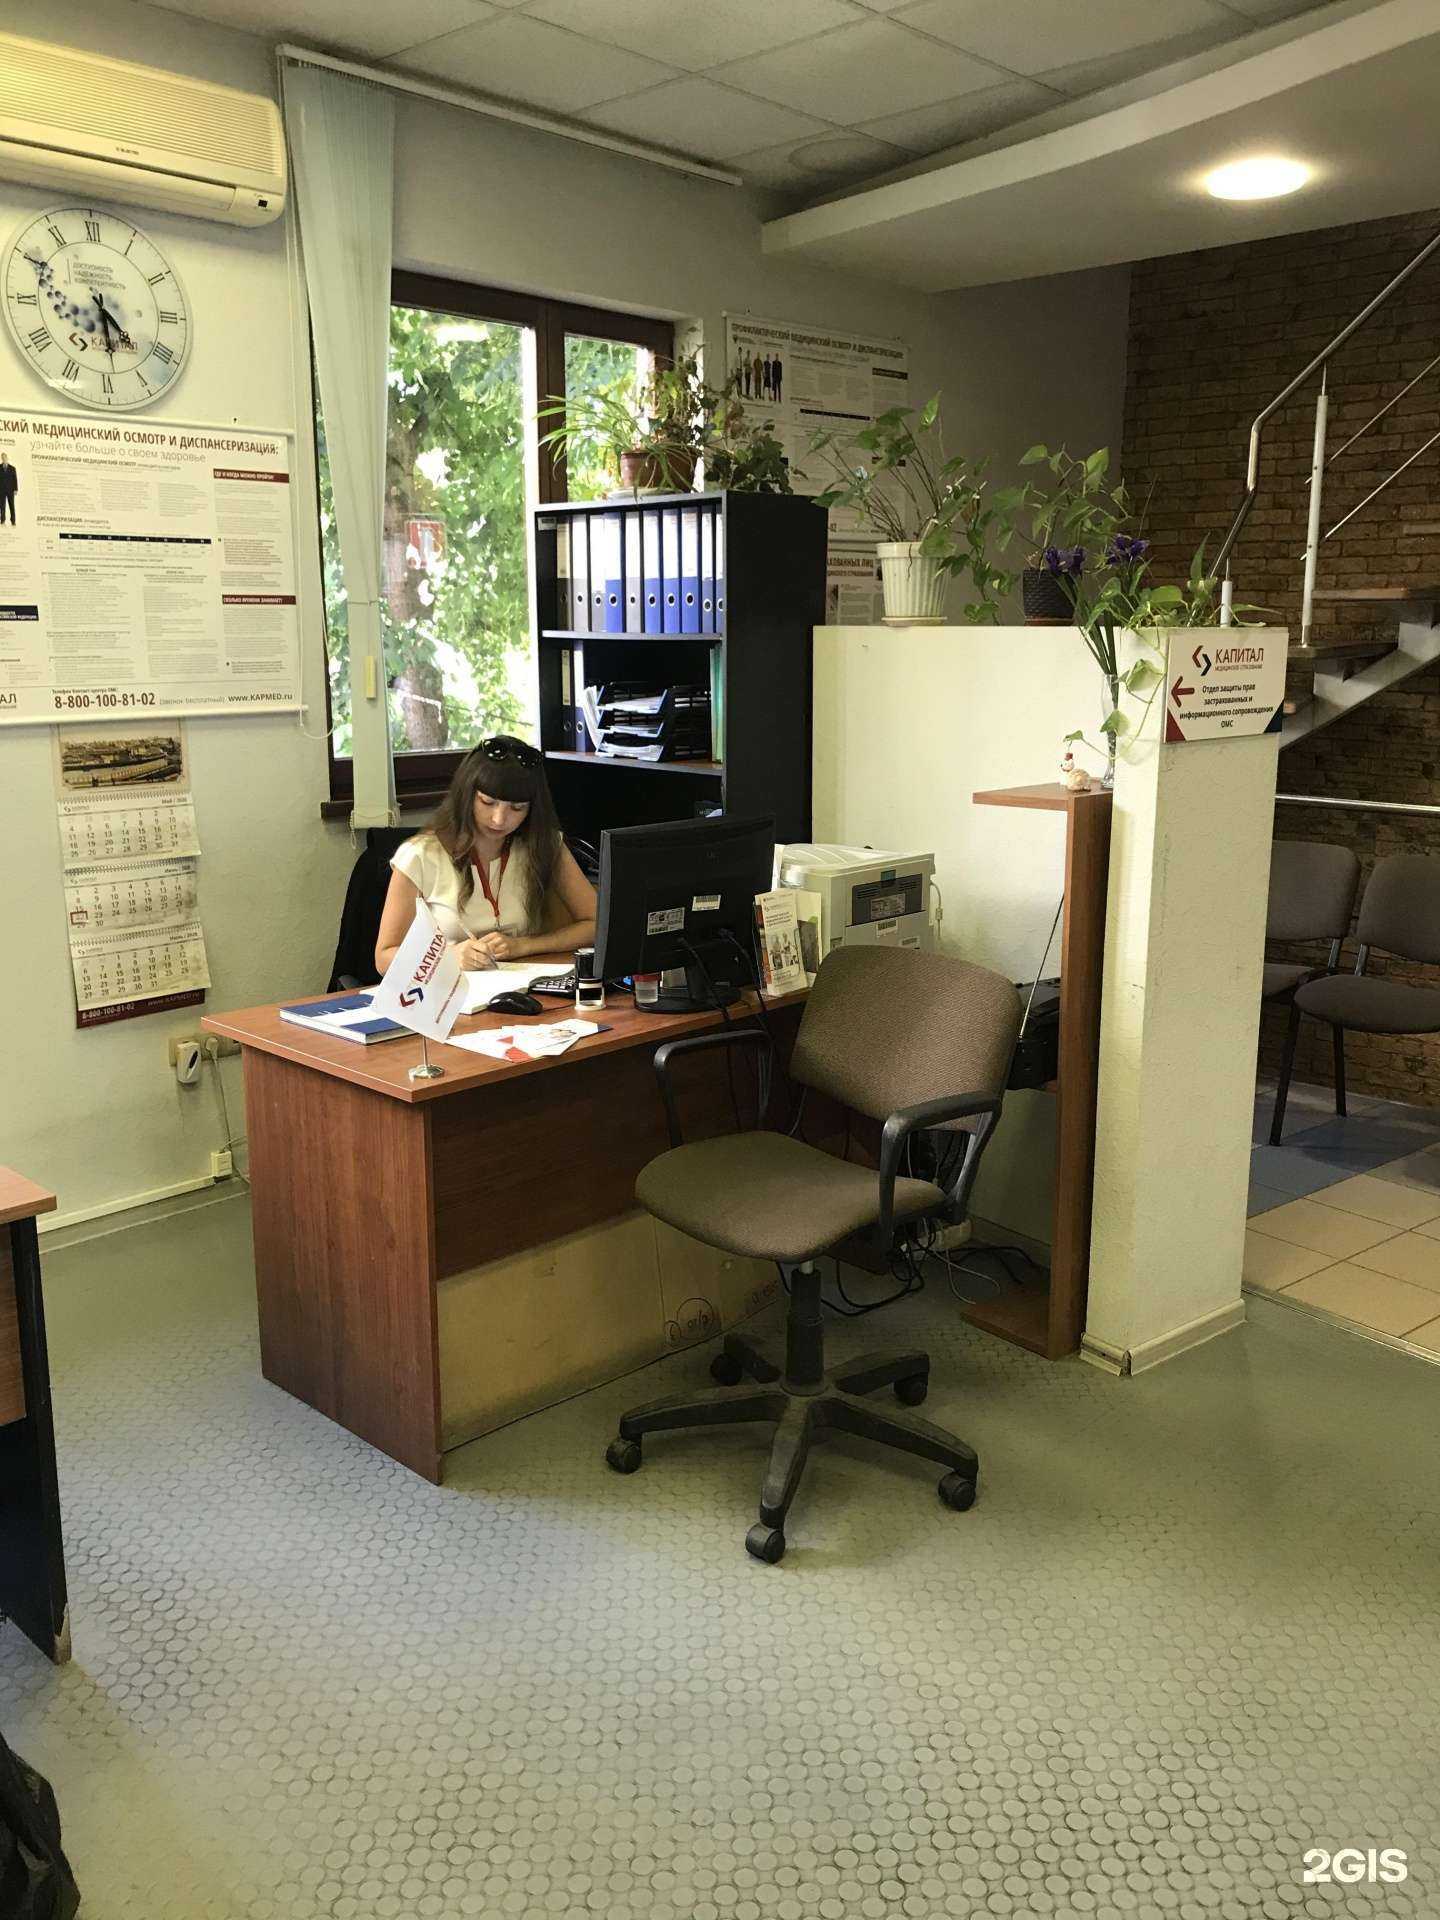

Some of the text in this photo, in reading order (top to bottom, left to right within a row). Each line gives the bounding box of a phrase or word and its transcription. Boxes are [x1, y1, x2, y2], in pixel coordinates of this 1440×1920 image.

[85, 221, 101, 243] XII
[148, 273, 166, 286] II
[160, 311, 179, 325] III
[32, 422, 120, 442] МЕДИЦИНСКИЙ
[124, 431, 166, 445] ОСМОТР
[169, 435, 177, 446] И
[76, 442, 116, 456] больше
[1215, 648, 1264, 664] КАПИТАЛ
[1202, 684, 1256, 693] Отдел защиты прав
[54, 692, 156, 708] 8-800-100-81-02
[228, 693, 293, 702] www.KAPMED.ru
[1220, 720, 1234, 728] ОМС
